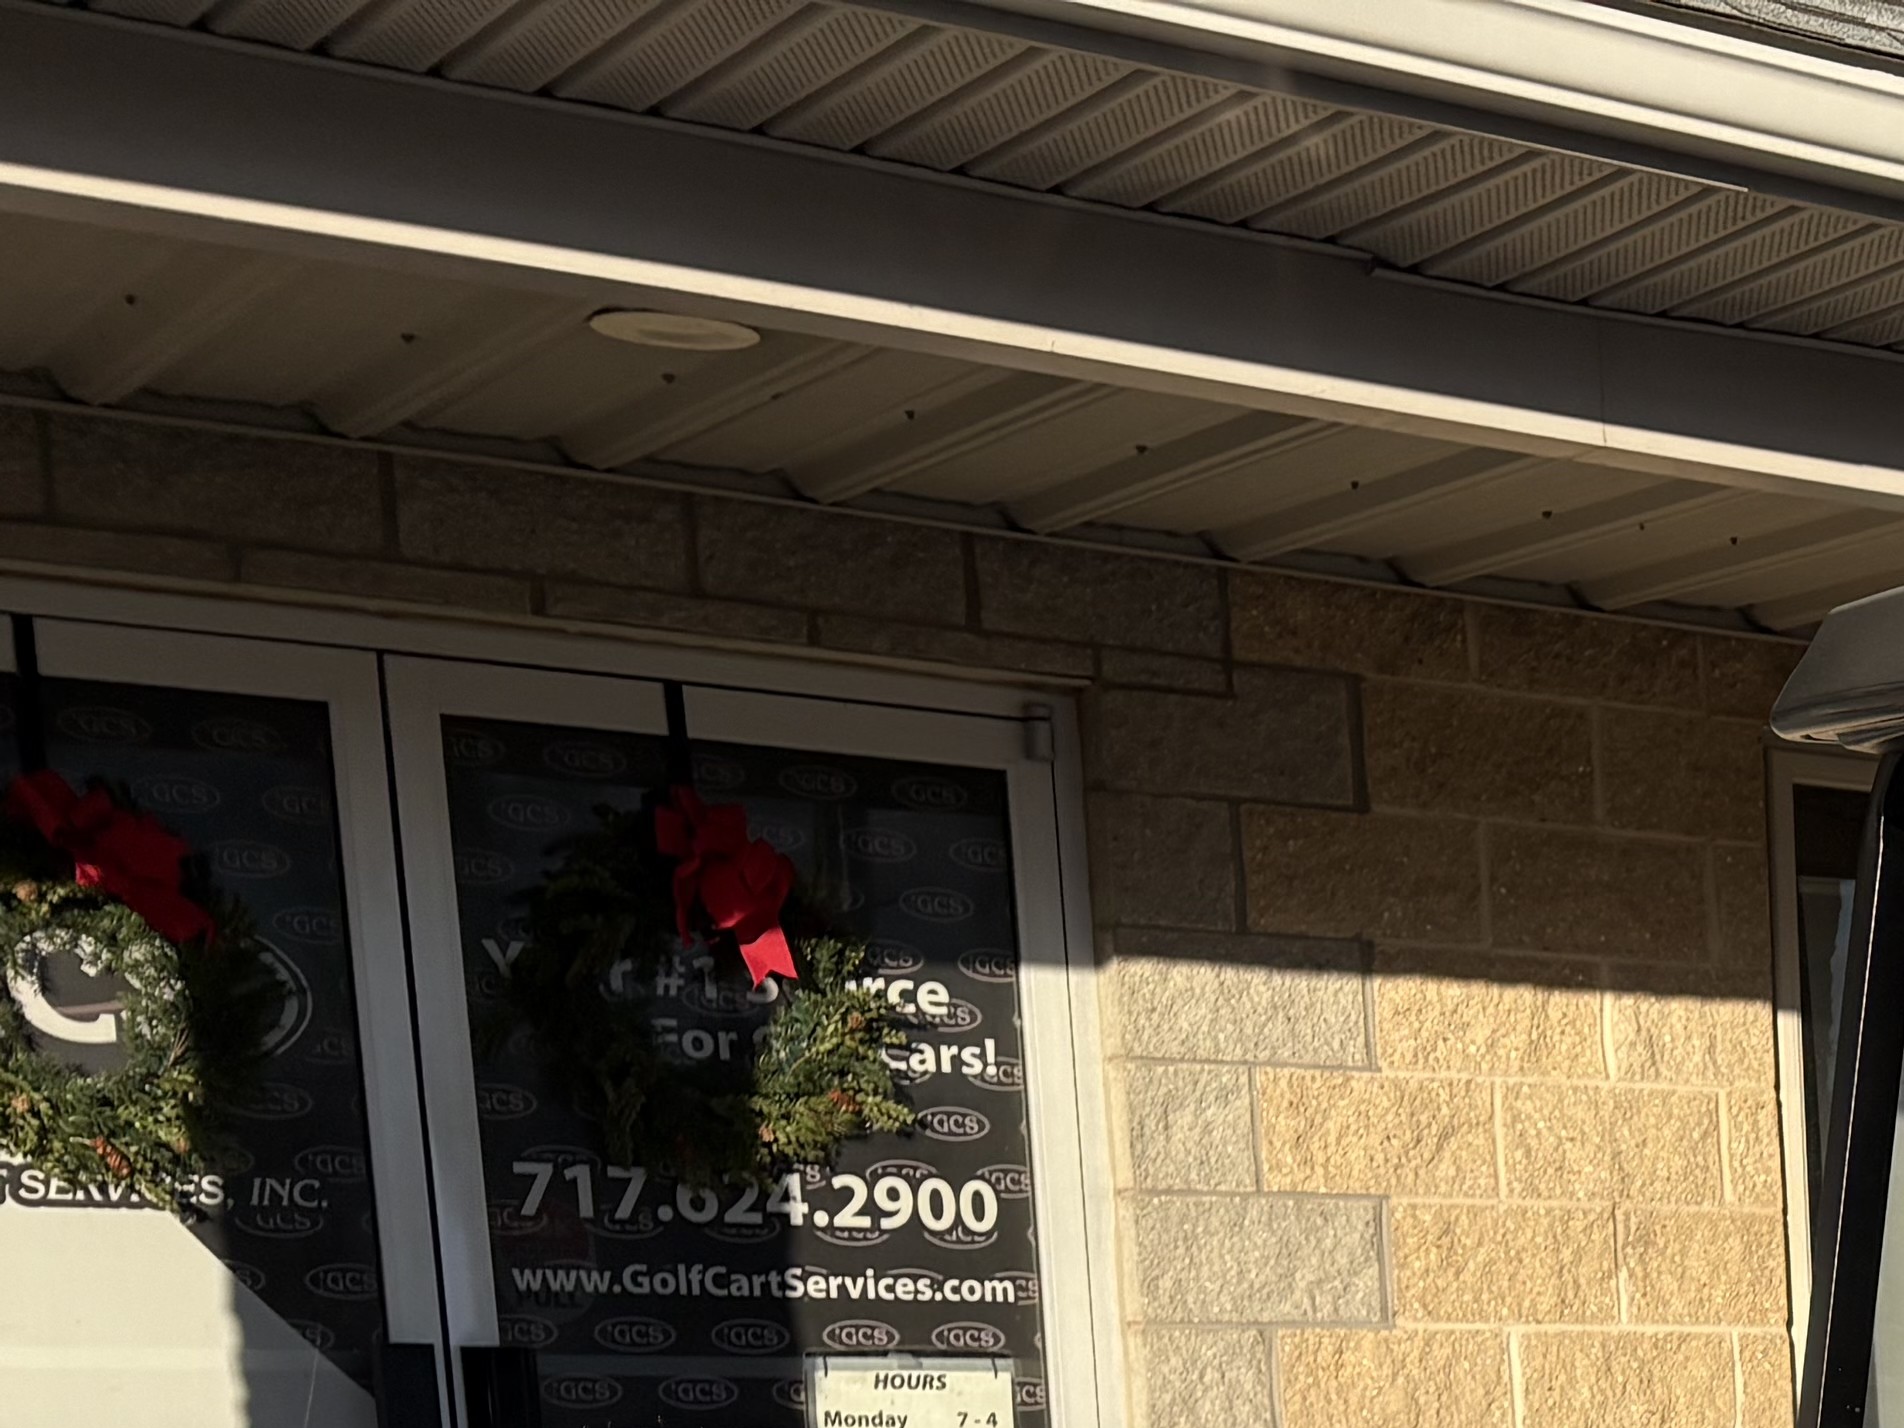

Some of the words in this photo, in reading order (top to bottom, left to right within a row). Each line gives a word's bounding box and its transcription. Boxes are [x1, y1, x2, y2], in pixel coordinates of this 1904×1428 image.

[481, 937, 632, 994] Yr
[933, 1112, 980, 1134] GCS
[250, 1176, 329, 1208] INC.
[512, 1161, 998, 1233] 717.624.2900
[511, 1263, 1016, 1304] www.GolfCartServices.com
[614, 1326, 664, 1345] GCS
[730, 1327, 780, 1346] GCS
[840, 1326, 890, 1347] GCS
[949, 1327, 995, 1348] GCS
[560, 1380, 611, 1400] GCS
[677, 1381, 728, 1400] GCS
[873, 1372, 947, 1391] HOURS
[957, 1411, 968, 1428] 7
[986, 1411, 998, 1428] 4
